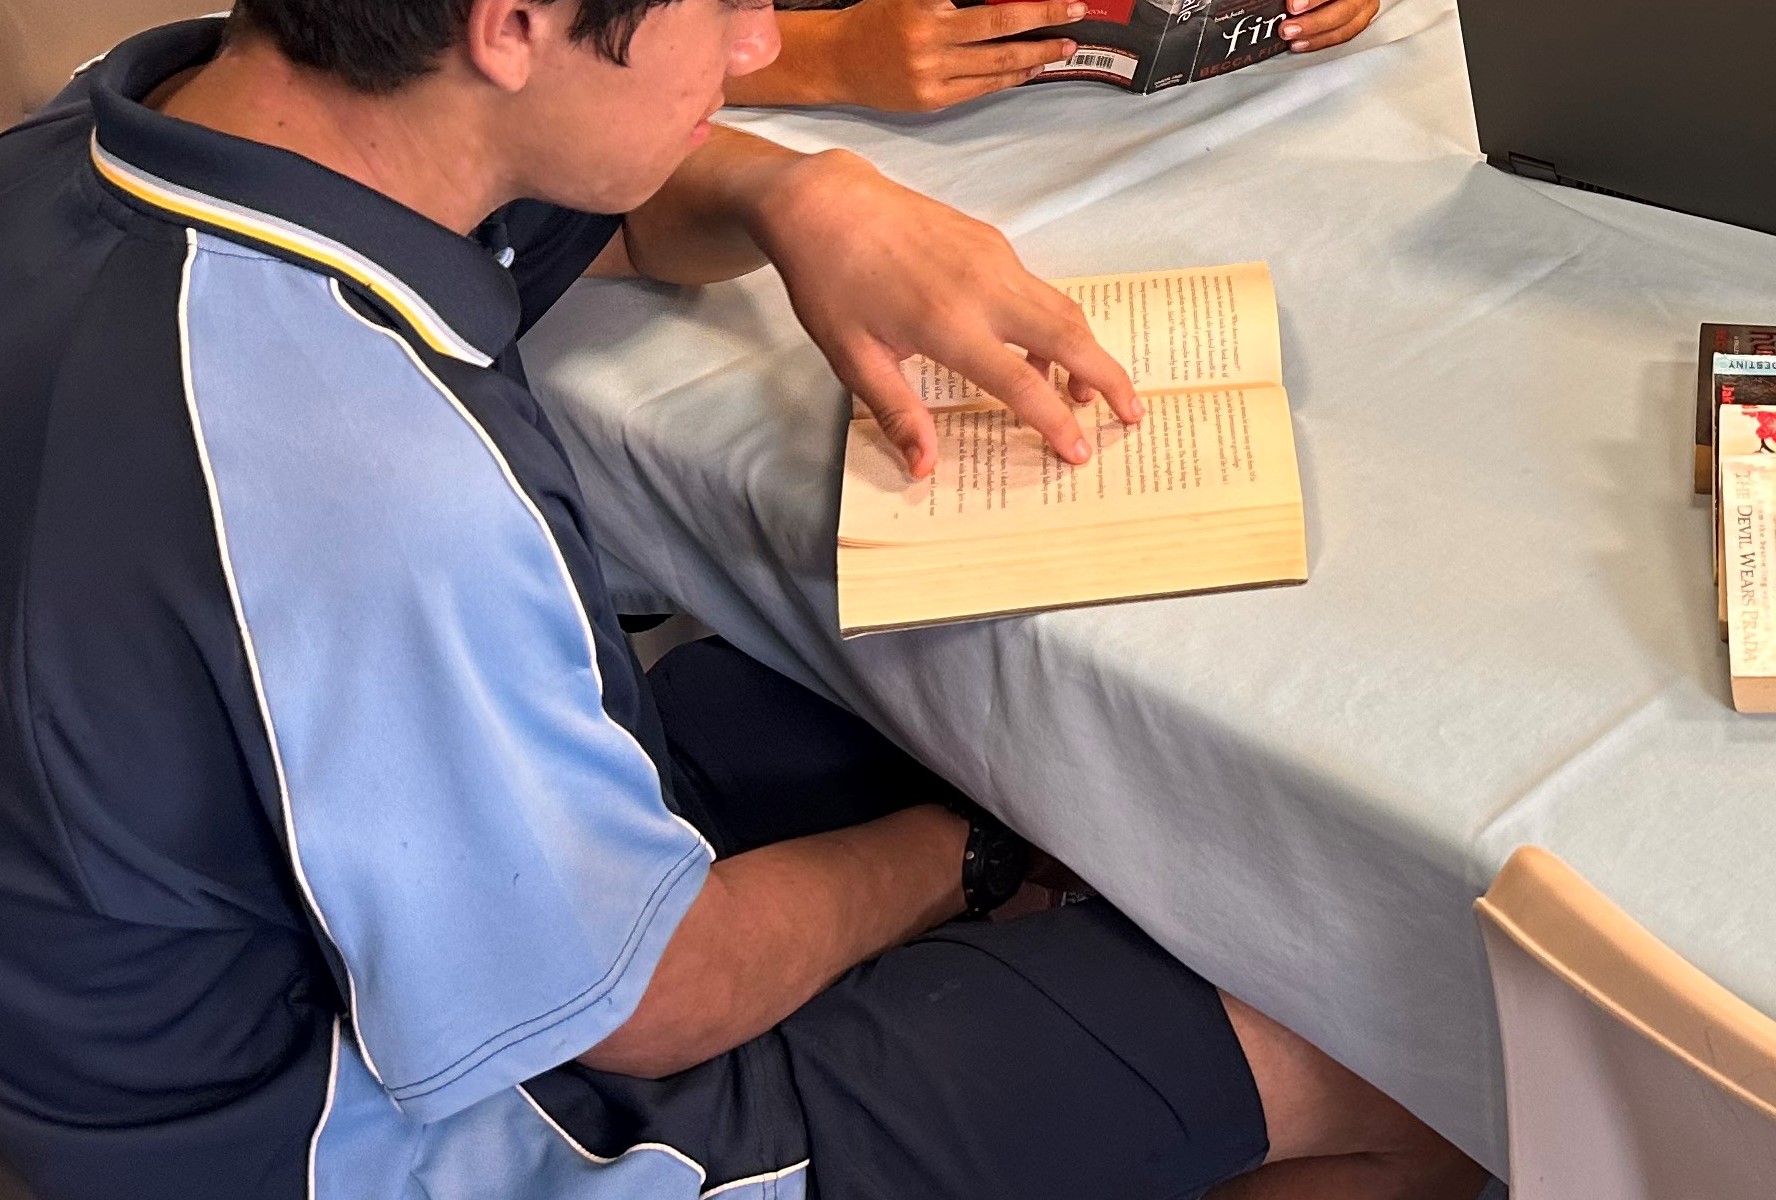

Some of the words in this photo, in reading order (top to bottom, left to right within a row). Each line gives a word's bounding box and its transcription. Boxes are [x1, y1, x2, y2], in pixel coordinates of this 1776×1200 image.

[1737, 505, 1753, 550] DEVIL
[1740, 551, 1756, 607] WEARS
[1742, 610, 1758, 665] PRADA
